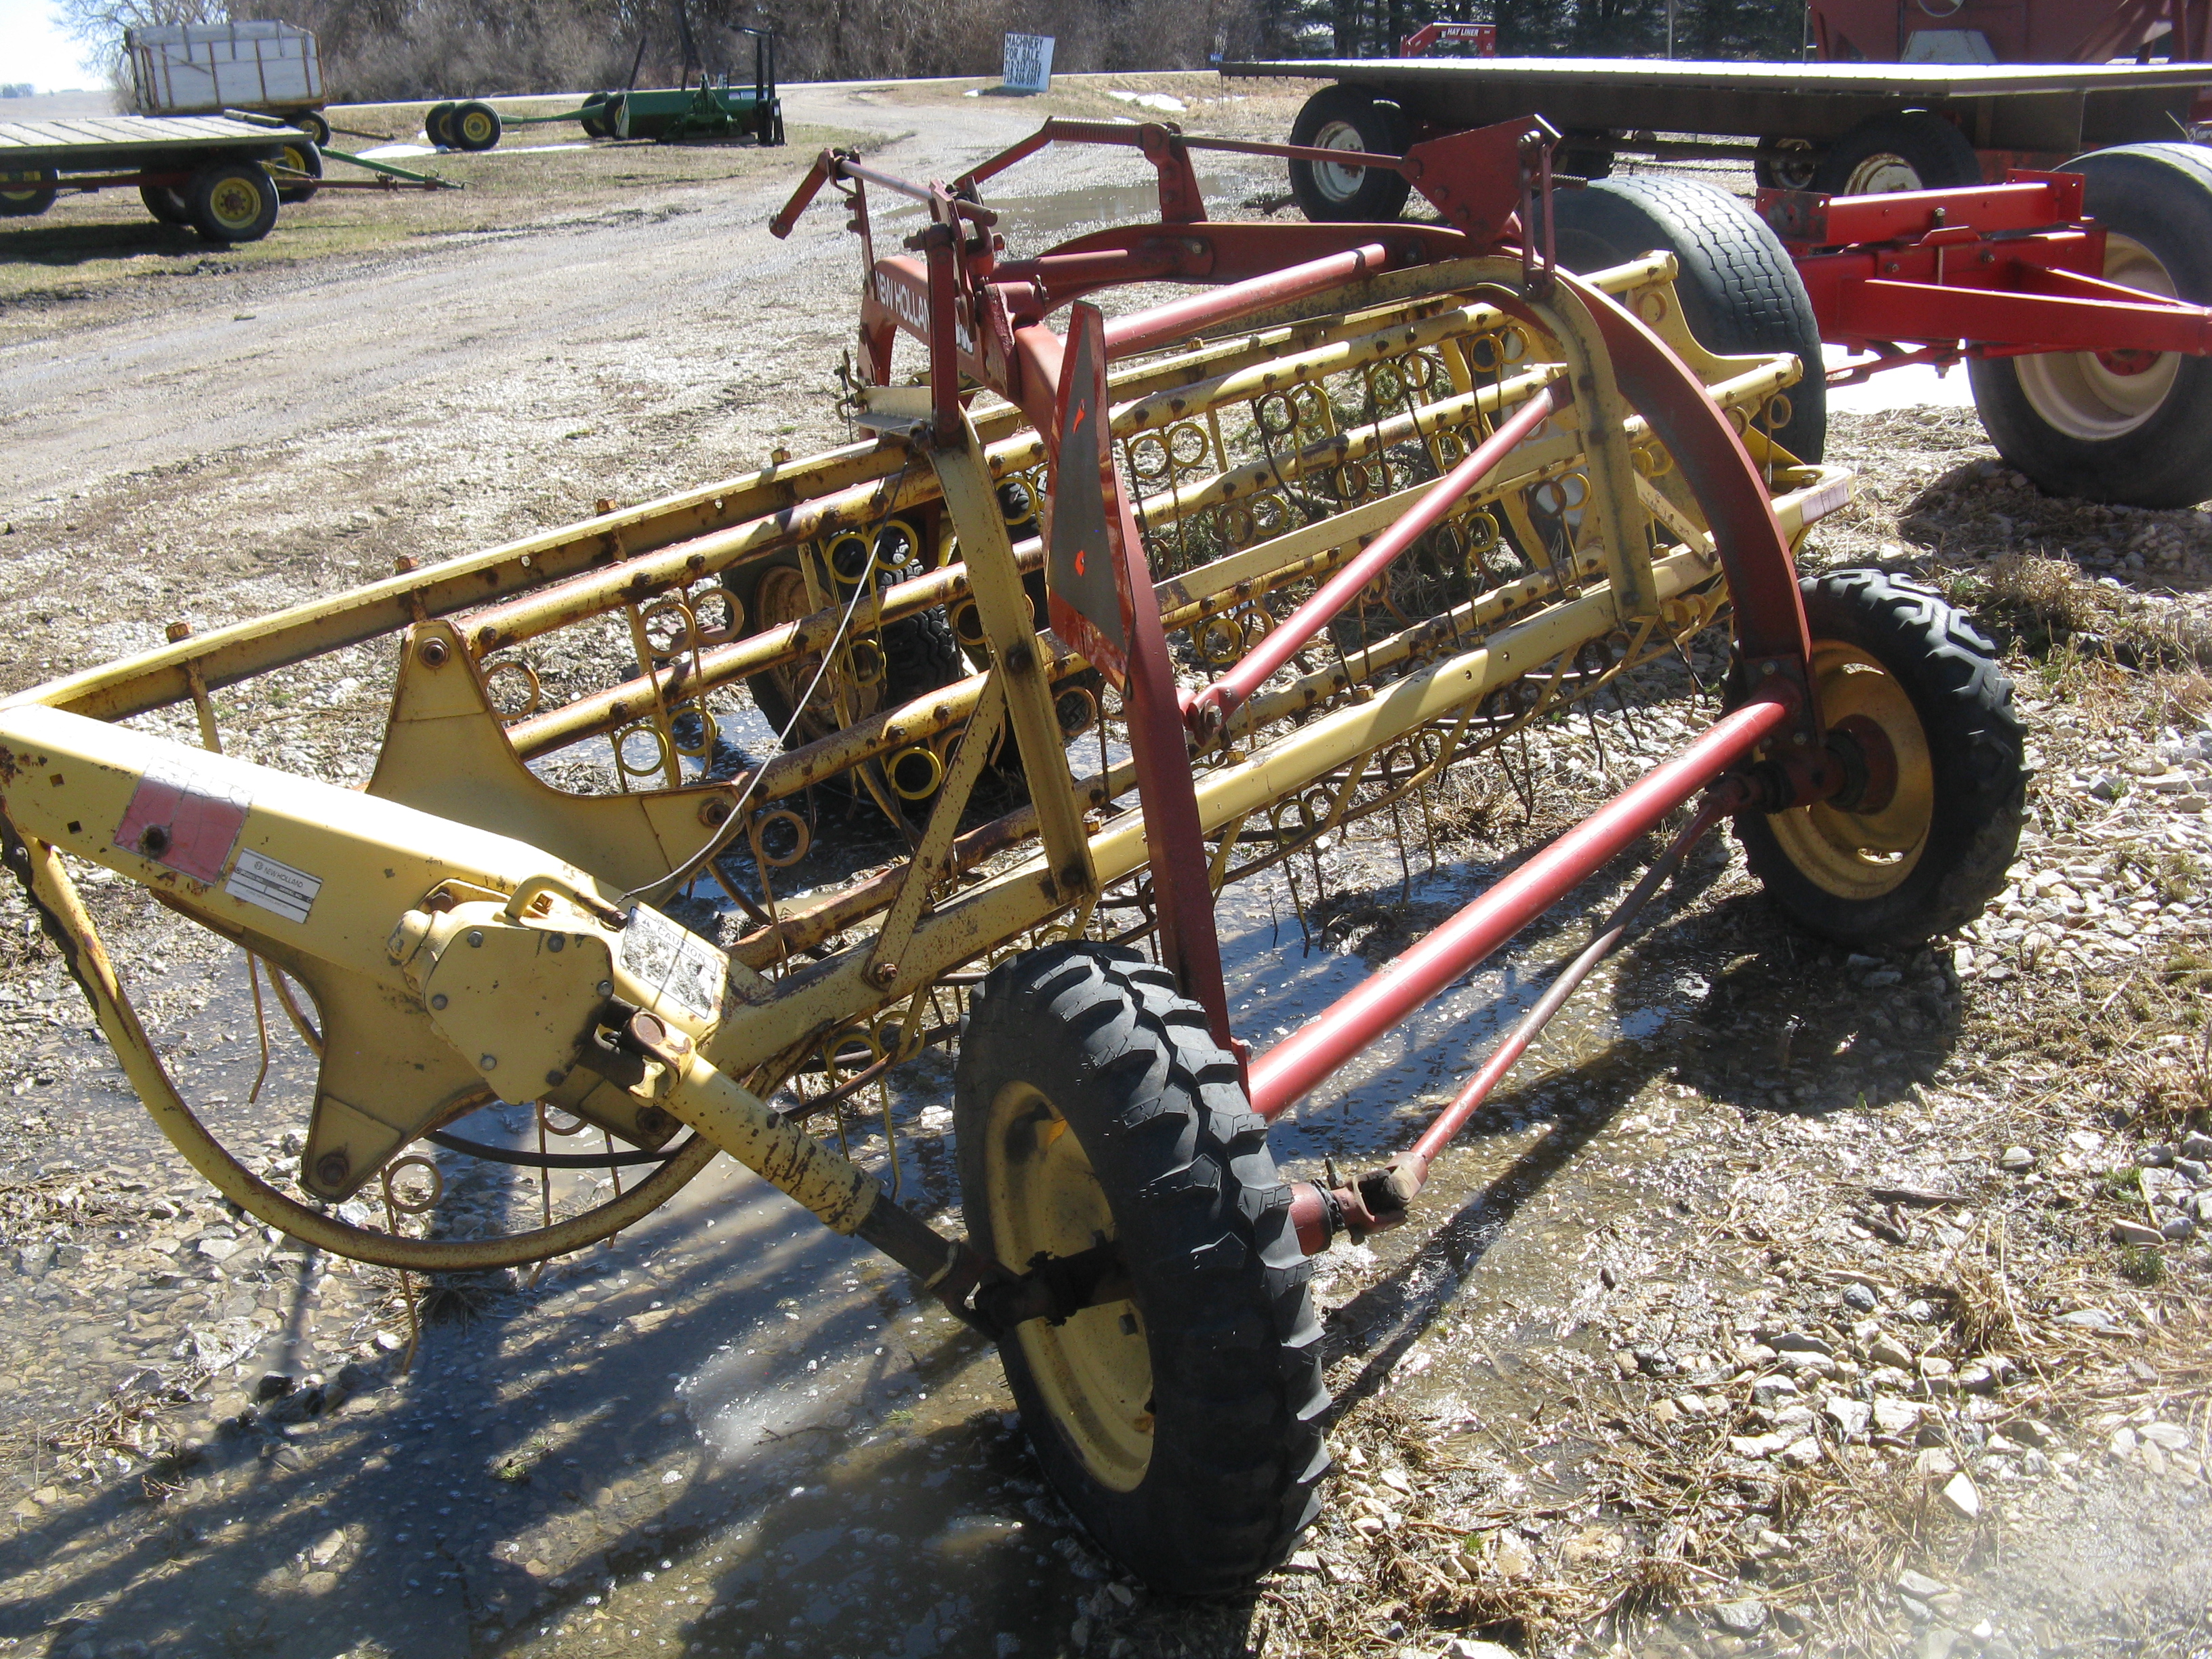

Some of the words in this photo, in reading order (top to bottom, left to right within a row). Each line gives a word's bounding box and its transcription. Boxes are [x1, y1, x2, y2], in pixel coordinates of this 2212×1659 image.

[1447, 27, 1460, 36] HAY
[1460, 28, 1479, 37] LINER
[1006, 34, 1044, 49] MACHINERY
[1005, 47, 1019, 60] FOR
[1022, 49, 1040, 62] SALE
[875, 270, 893, 310] NEW
[895, 281, 930, 333] HOLLAN
[264, 867, 277, 877] NEW
[276, 872, 304, 888] HOLLAND
[657, 926, 705, 963] CAUTION
